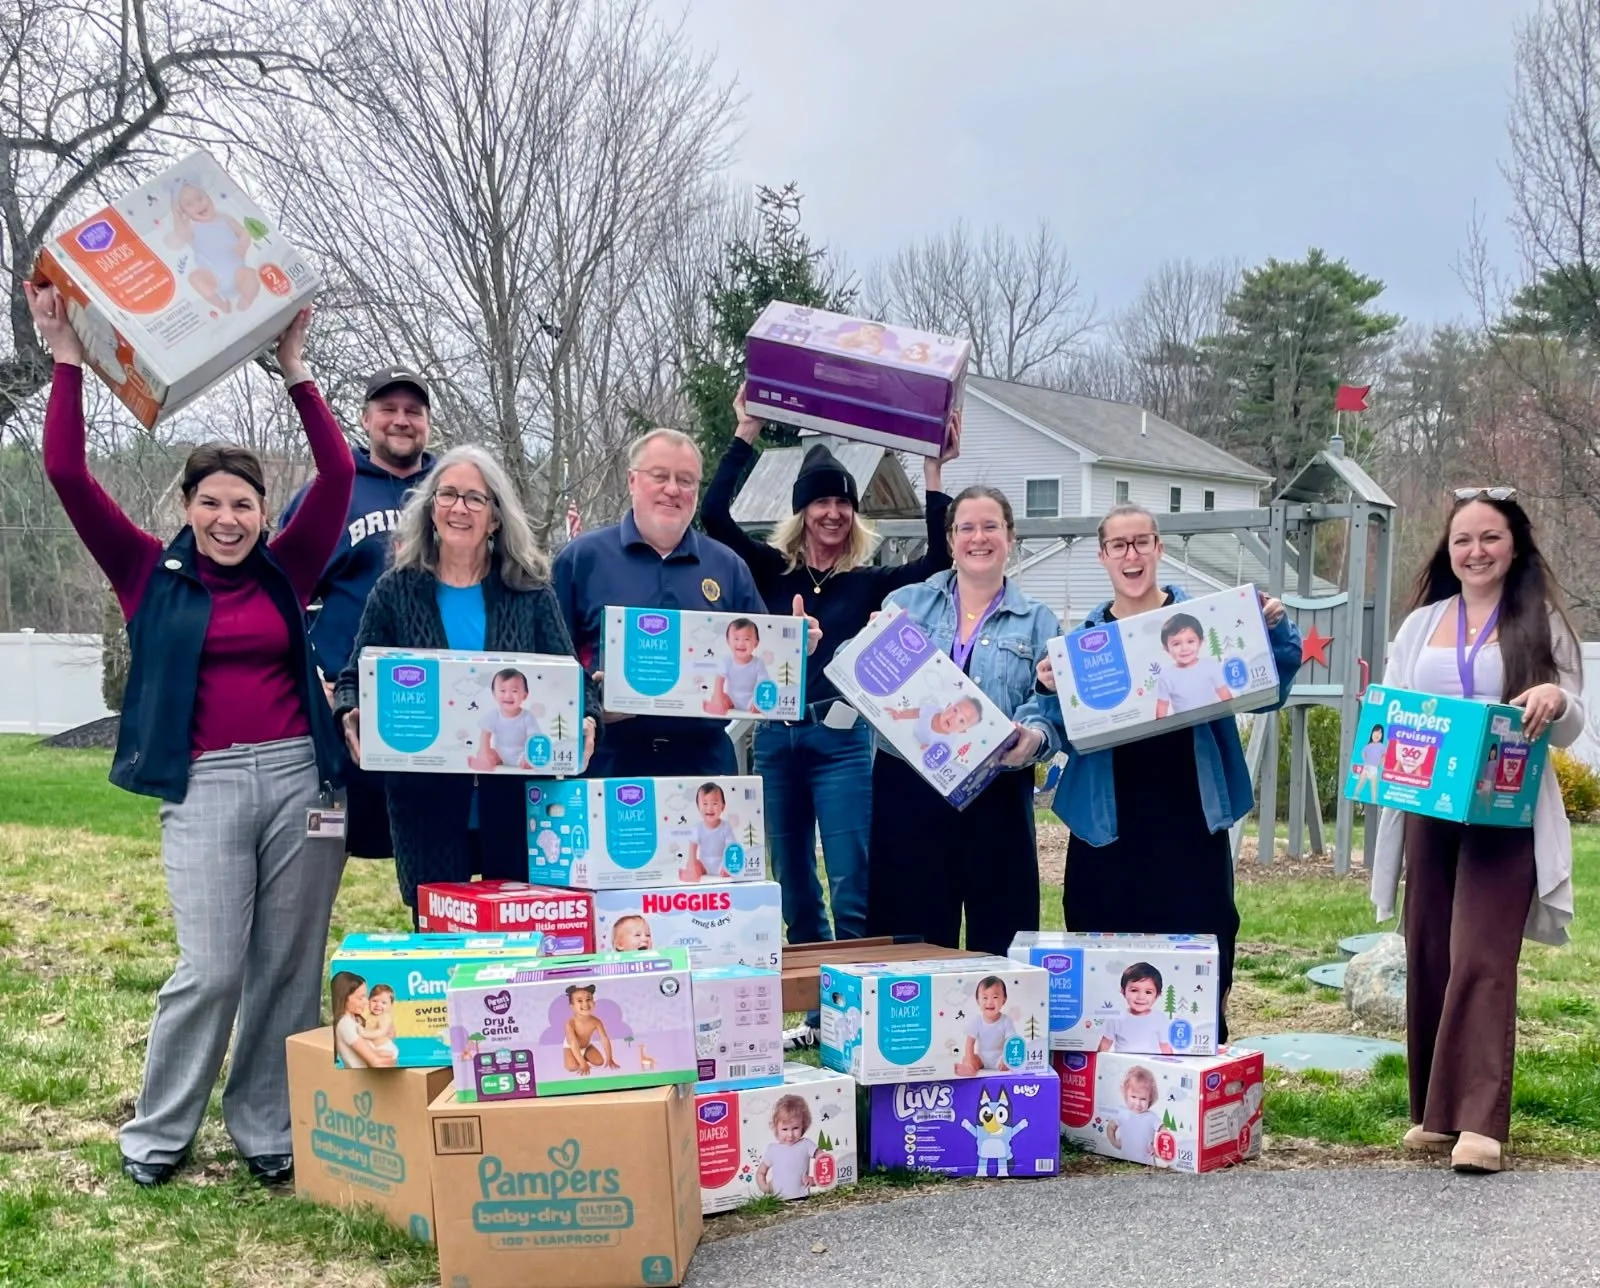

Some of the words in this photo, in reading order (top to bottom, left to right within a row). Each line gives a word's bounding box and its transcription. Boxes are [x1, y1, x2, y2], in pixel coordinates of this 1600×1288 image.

[285, 262, 305, 281] 180
[266, 273, 280, 285] 2
[348, 509, 403, 547] BRI
[1231, 666, 1240, 678] 6
[1250, 665, 1267, 679] 112
[392, 691, 426, 704] DIAPERS
[762, 689, 771, 700] 4
[778, 695, 796, 706] 144
[1387, 699, 1452, 733] Pampers
[1395, 730, 1437, 744] cruisers
[535, 743, 544, 756] 4
[552, 750, 573, 762] 144
[932, 749, 944, 760] 3
[1401, 747, 1422, 760] 360
[1447, 756, 1458, 771] 5
[731, 851, 738, 863] 4
[744, 857, 761, 868] 144
[428, 891, 478, 927] HUGGIES
[642, 892, 731, 914] HUGGIES
[500, 900, 588, 924] HUGGIES
[535, 921, 556, 931] little
[557, 921, 588, 931] movers
[717, 916, 731, 927] dry
[769, 952, 778, 965] 5
[890, 1005, 921, 1018] DIAPERS
[484, 1017, 505, 1028] Dry
[507, 1016, 515, 1024] &
[482, 1026, 520, 1036] Gentle
[1176, 1027, 1185, 1039] 6
[1194, 1034, 1210, 1045] 112
[1011, 1044, 1019, 1057] 4
[1026, 1050, 1043, 1061] 144
[499, 1076, 510, 1090] 5
[894, 1083, 951, 1119] Luvs
[313, 1089, 397, 1149] Pampers
[699, 1126, 729, 1142] DIAPERS
[1162, 1139, 1170, 1151] 5
[906, 1154, 915, 1166] 3
[1177, 1149, 1193, 1161] 128
[821, 1162, 829, 1175] 5
[836, 1165, 853, 1179] 128
[478, 1155, 620, 1201] Pampers
[580, 1203, 623, 1215] ULTRA
[533, 1233, 610, 1246] LEAKPROOF
[650, 1259, 663, 1274] 4
